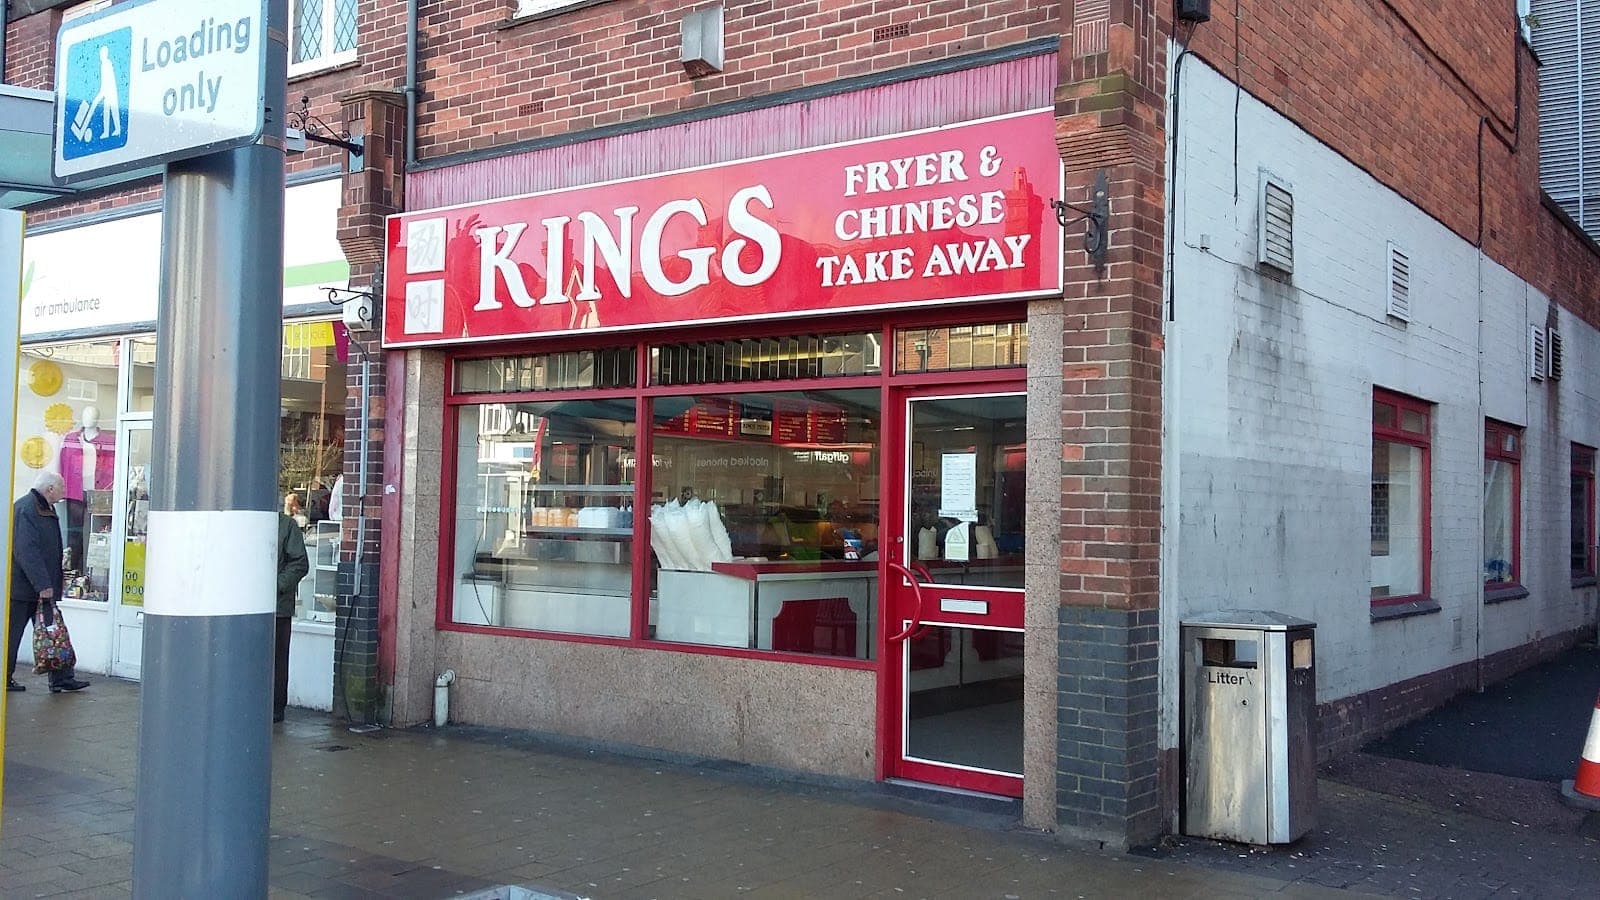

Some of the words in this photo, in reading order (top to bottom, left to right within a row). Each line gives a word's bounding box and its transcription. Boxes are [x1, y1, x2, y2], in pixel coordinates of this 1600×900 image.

[142, 17, 251, 72] Loading
[163, 71, 222, 116] only
[843, 149, 969, 197] FRYER
[978, 145, 1003, 178] &
[834, 190, 1006, 241] CHINESE
[473, 184, 783, 312] KINGS
[815, 246, 916, 288] TAKE
[922, 234, 1032, 278] AWAY
[34, 303, 46, 318] air
[48, 297, 101, 316] ambulance
[1208, 671, 1245, 685] Litter
